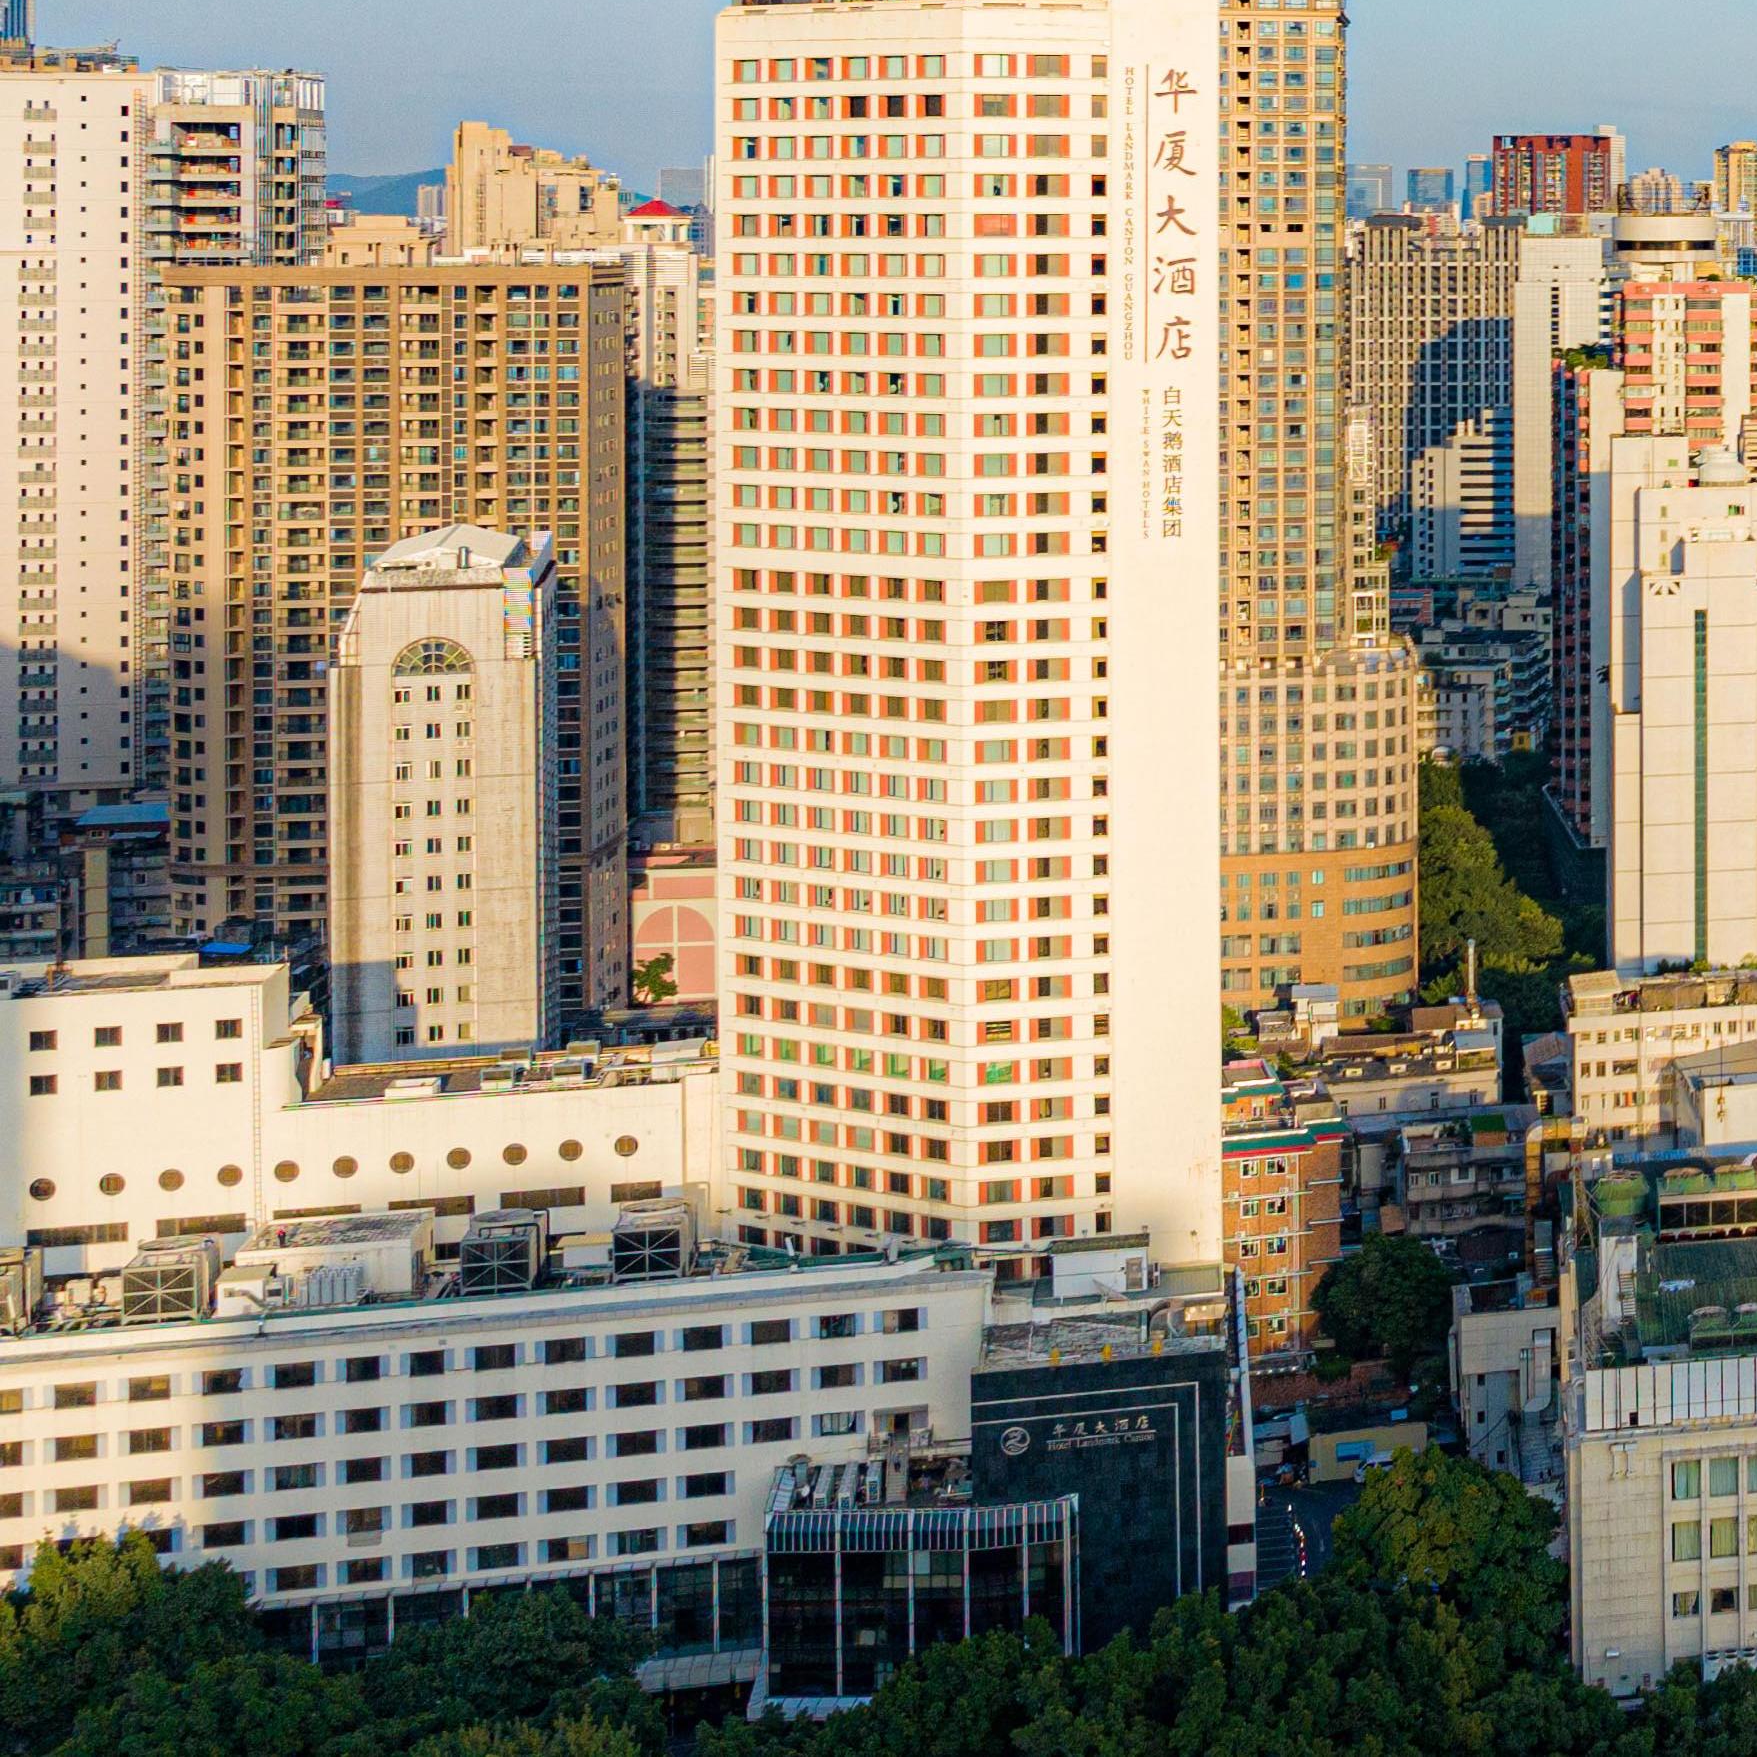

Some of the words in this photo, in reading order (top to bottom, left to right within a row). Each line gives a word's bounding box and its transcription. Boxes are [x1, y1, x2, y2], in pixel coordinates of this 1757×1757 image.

[1124, 66, 1136, 115] HOTEL
[1123, 122, 1136, 201] LANDMARK
[1123, 207, 1135, 266] CANTON
[1153, 68, 1198, 360] 华厦大酒店
[1123, 273, 1135, 361] GUANGZHOU
[1142, 389, 1151, 435] WHITE
[1142, 439, 1151, 476] SWAN
[1162, 385, 1183, 539] 白天鹅酒店集团
[1142, 481, 1151, 540] HOTELS
[1052, 1415, 1149, 1438] 华厦大酒店
